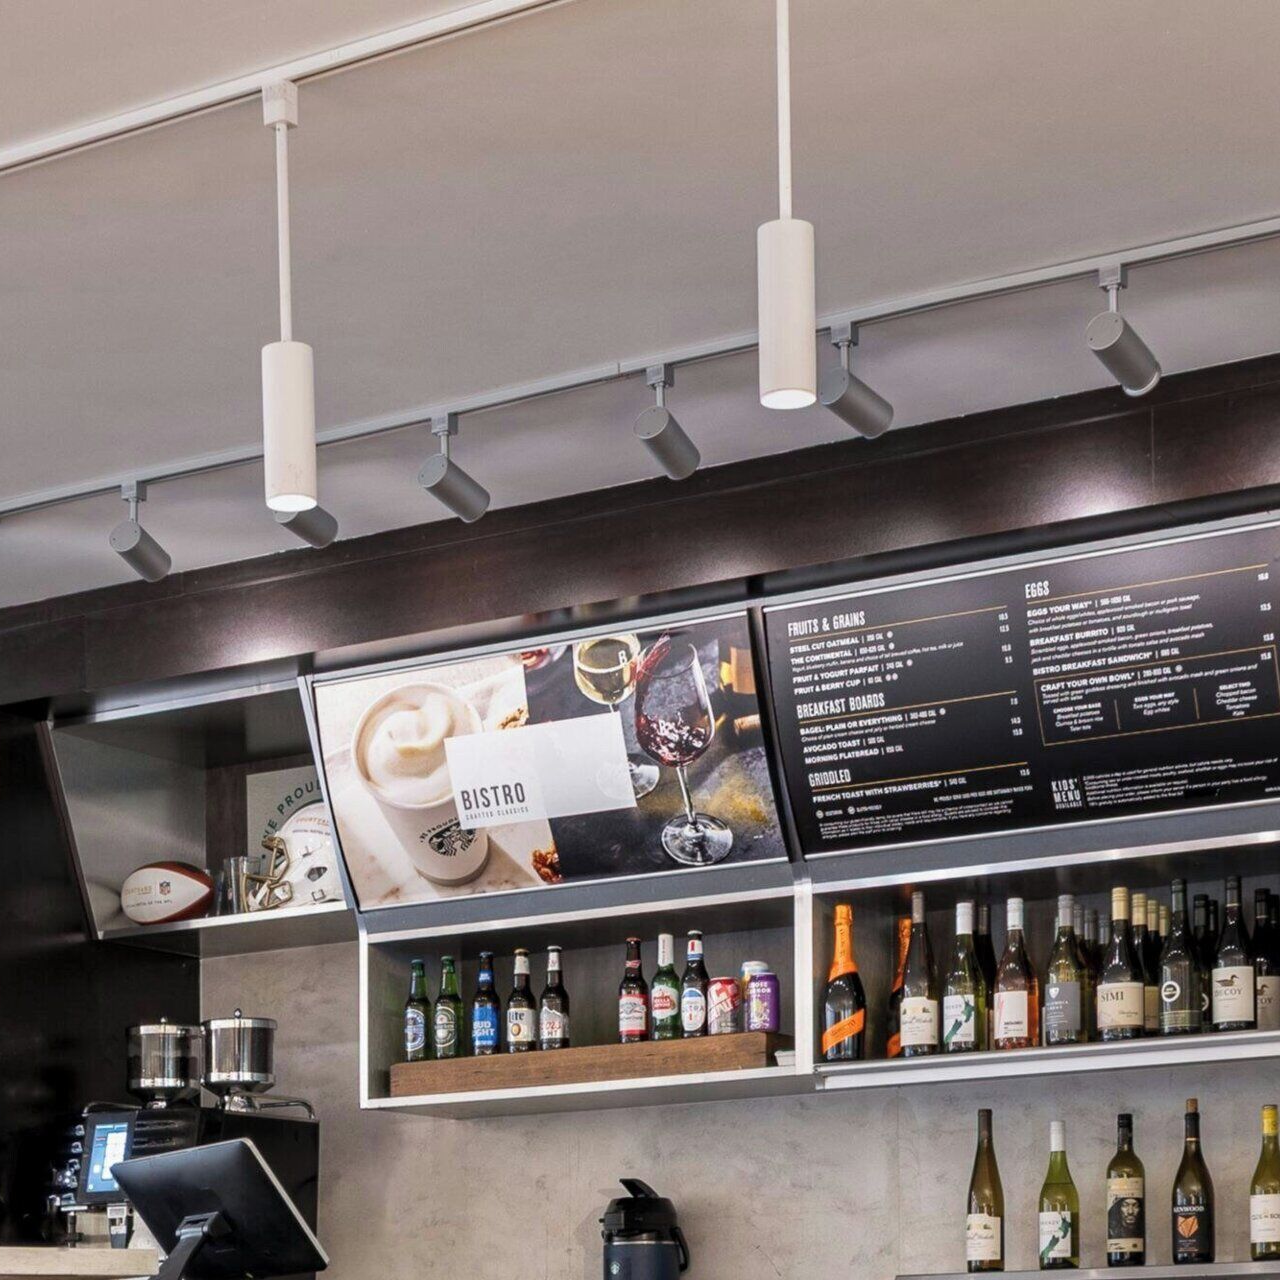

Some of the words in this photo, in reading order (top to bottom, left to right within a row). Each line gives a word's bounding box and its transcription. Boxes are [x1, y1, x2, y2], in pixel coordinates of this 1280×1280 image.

[1025, 581, 1049, 599] EGGS
[1027, 607, 1048, 617] EGGS
[1049, 604, 1070, 614] YOUR
[788, 618, 818, 637] FRUITS
[822, 617, 829, 632] &
[833, 612, 865, 630] GRAINS
[1030, 633, 1074, 646] BREAKFAST
[1075, 628, 1108, 640] BURRITO
[791, 656, 804, 666] THE
[805, 650, 852, 664] CONTINENTAL
[793, 674, 812, 684] FRUIT
[814, 673, 819, 681] &
[820, 669, 848, 680] YOGURT
[849, 665, 879, 676] PARFAIT
[797, 698, 845, 719] BREAKFAST
[849, 693, 885, 712] BOARDS
[826, 722, 846, 732] PLAIN
[847, 721, 857, 729] OR
[859, 715, 903, 728] EVERYTHING
[803, 742, 837, 753] AVOCADO
[838, 740, 860, 749] TOAST
[805, 753, 838, 764] MORNING
[839, 748, 879, 760] FLATBREAD
[809, 769, 851, 787] GRIDDLED
[461, 782, 526, 810] BISTRO
[813, 793, 841, 803] FRENCH
[842, 790, 863, 800] TOAST
[865, 788, 883, 797] WITH
[1054, 790, 1080, 802] MENU
[466, 811, 494, 820] CRAFTED
[498, 806, 529, 816] CLASSICS
[1101, 991, 1124, 1001] SIMI
[508, 1011, 525, 1023] Lite
